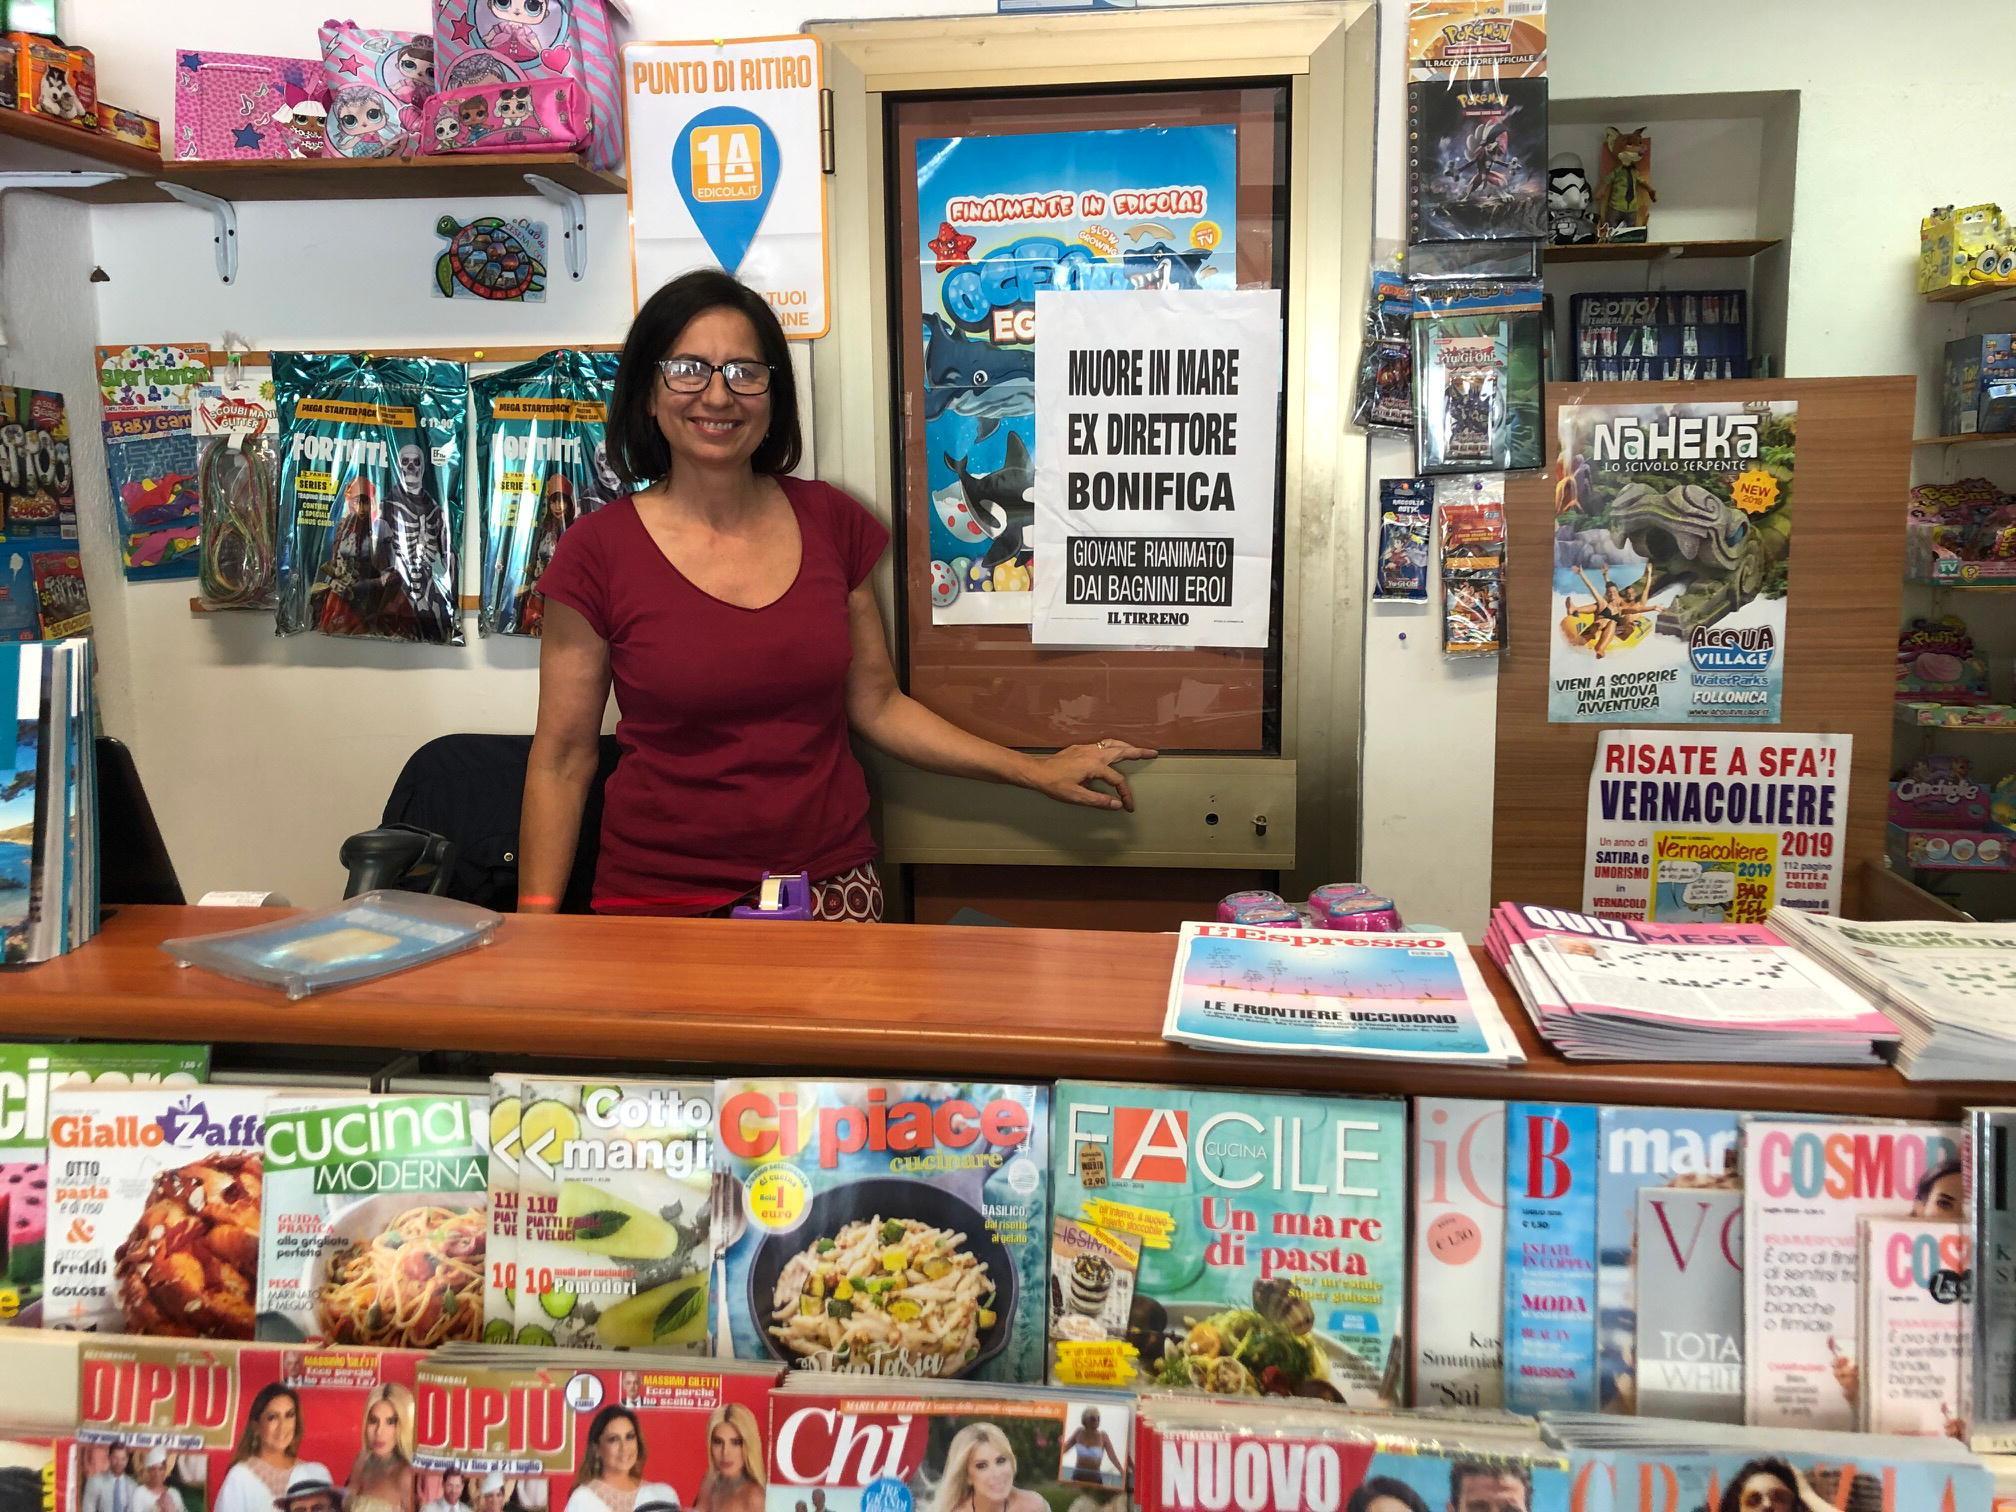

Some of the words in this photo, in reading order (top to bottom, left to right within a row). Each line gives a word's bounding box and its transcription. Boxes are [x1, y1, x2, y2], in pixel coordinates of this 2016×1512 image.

[1434, 57, 1492, 67] RACCOGLITORE
[1494, 54, 1534, 64] UFFICIALE
[633, 60, 707, 94] PUNTO
[713, 60, 734, 92] DI
[741, 55, 812, 91] RITIRO
[697, 184, 758, 198] EDICOLA.IT
[1082, 194, 1105, 217] IN
[1090, 225, 1119, 244] SLOW
[1197, 235, 1213, 246] TV
[1079, 231, 1118, 256] GROWING
[767, 291, 806, 305] TUOI
[1069, 349, 1143, 396] MUORE
[1149, 349, 1170, 395] IN
[1177, 349, 1239, 395] MARE
[210, 405, 248, 420] SCOUBI
[302, 405, 323, 413] MEGA
[325, 405, 358, 416] STARTER
[358, 408, 377, 418] PACK
[499, 403, 520, 412] MEGA
[222, 418, 259, 429] GLITTER
[1068, 413, 1098, 455] EX
[1107, 412, 1237, 455] DIRETTORE
[1605, 461, 1620, 472] LO
[1624, 460, 1679, 473] SCIVOLO
[1683, 459, 1747, 472] SERPENTE
[299, 480, 327, 491] SERIES
[1068, 471, 1235, 511] BONIFICA
[1740, 483, 1771, 498] NEW
[1073, 539, 1136, 568] GIOVANE
[1144, 541, 1226, 569] RIANIMATO
[1073, 574, 1101, 601] DAI
[1108, 575, 1178, 602] BAGNINI
[1185, 576, 1226, 603] EROI
[1107, 612, 1124, 624] IL
[1126, 612, 1189, 625] TIRRENO
[1693, 626, 1774, 653] ACQUA
[1694, 651, 1768, 666] VILLAGE
[1556, 677, 1591, 692] VIENI
[1596, 675, 1606, 688] A
[1610, 669, 1679, 687] SCOPRIRE
[1693, 673, 1769, 687] WaterParks
[1577, 688, 1605, 702] UNA
[1610, 685, 1658, 700] NUOVA
[1693, 690, 1768, 704] FOLLONICA
[1576, 696, 1660, 715] AVVENTURA
[1605, 744, 1717, 775] RISATE
[1727, 746, 1748, 776] A
[1759, 746, 1837, 777] SFA'!
[1600, 779, 1836, 826] VERNACOLIERE
[1600, 837, 1612, 847] Un
[1614, 838, 1636, 848] anno
[1638, 837, 1648, 848] di
[1657, 836, 1768, 861] Vernacoliere
[1782, 830, 1833, 858] 2019
[1596, 851, 1639, 864] SATIRA
[1641, 854, 1650, 865] e
[1784, 861, 1799, 870] 112
[1801, 862, 1832, 872] pagine
[1594, 866, 1649, 880] UMORISMO
[1738, 862, 1772, 877] 2019
[1785, 872, 1818, 880] TUTTE
[1615, 884, 1626, 894] in
[1736, 883, 1767, 900] BAR
[1785, 881, 1827, 890] COLORI
[1593, 897, 1647, 909] VERNACOLO
[1522, 905, 1636, 942] QUIZ
[1643, 931, 1773, 947] MESE
[1204, 1000, 1226, 1011] LE
[1233, 1003, 1343, 1021] FRONTIERE
[1350, 1011, 1458, 1024] UCCIDONO
[585, 1088, 712, 1128] Cotto
[51, 1116, 164, 1148] Giallo
[265, 1100, 466, 1166] cucina
[720, 1089, 797, 1157] Ci
[819, 1088, 1029, 1169] piace
[563, 1129, 714, 1179] mangi
[1067, 1102, 1380, 1197] FACILE
[1205, 1141, 1267, 1159] CUCINA
[1524, 1115, 1572, 1199] B
[66, 1160, 100, 1177] OTTO
[890, 1150, 1004, 1173] cucinare
[317, 1157, 488, 1191] MODERNA
[1083, 1176, 1106, 1187] €2,90
[55, 1186, 109, 1203] pasta
[527, 1196, 558, 1214] 110
[982, 1204, 1028, 1218] BASILICO,
[278, 1214, 320, 1224] GUIDA
[526, 1216, 564, 1228] PIATTI
[762, 1210, 792, 1218] euro
[1202, 1196, 1257, 1232] Un
[1272, 1210, 1383, 1242] mare
[67, 1218, 94, 1243] &
[278, 1223, 335, 1234] PRATICA
[536, 1229, 576, 1241] VELOCI
[277, 1235, 298, 1247] alla
[301, 1235, 349, 1248] grigliata
[276, 1248, 322, 1260] perfetta
[1203, 1232, 1246, 1267] di
[1260, 1247, 1368, 1280] pasta
[52, 1260, 107, 1275] freddi
[269, 1279, 300, 1288] PESCE
[525, 1267, 551, 1295] 10
[554, 1278, 637, 1295] Pomodori
[1522, 1294, 1587, 1312] MODA
[1764, 1301, 1835, 1316] bianche
[1661, 1331, 1742, 1362] TOTA
[643, 1375, 686, 1387] MASSIMO
[688, 1375, 719, 1387] GILETTI
[1661, 1363, 1742, 1391] WHIT
[579, 1375, 592, 1400] 1
[646, 1387, 672, 1396] Ecco
[675, 1387, 714, 1398] perché
[642, 1397, 657, 1406] ho
[660, 1397, 694, 1407] scelto
[697, 1397, 717, 1407] La7
[776, 1406, 914, 1486] Chi
[1161, 1440, 1341, 1512] NUOVO
